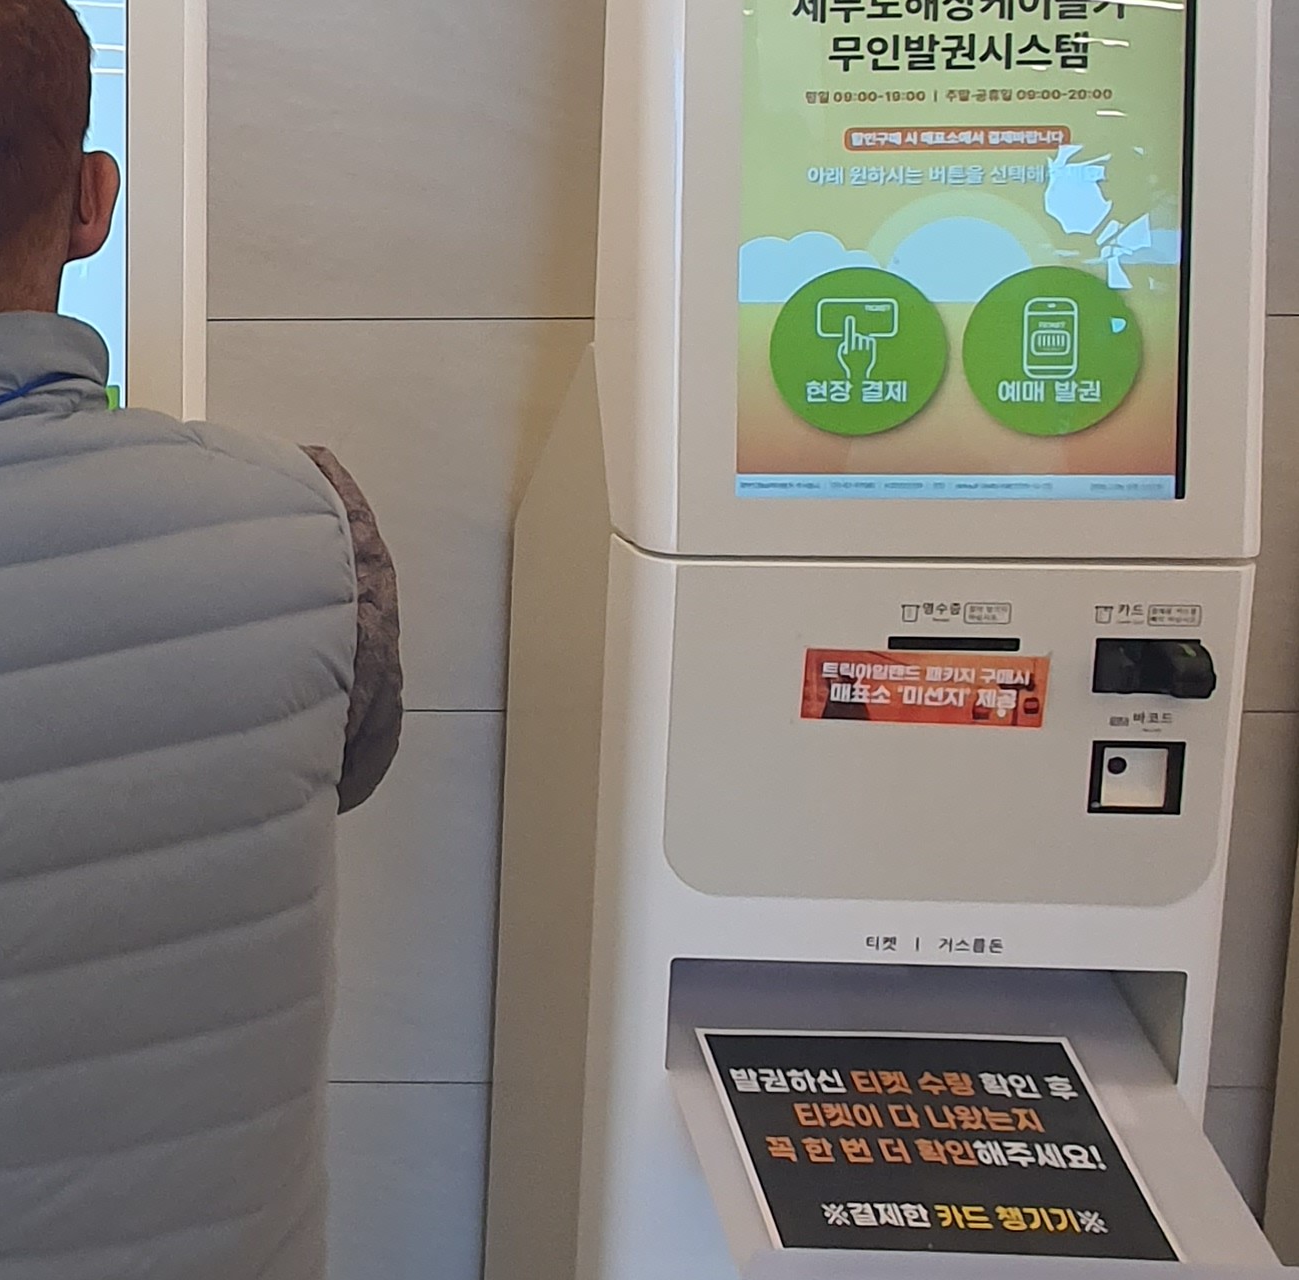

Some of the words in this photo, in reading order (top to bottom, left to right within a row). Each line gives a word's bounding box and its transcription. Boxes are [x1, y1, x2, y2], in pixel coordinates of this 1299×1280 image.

[828, 30, 1090, 72] 무인발권시스템
[905, 131, 918, 145] 시
[807, 165, 844, 185] 아래
[850, 165, 923, 186] 원하시는
[929, 165, 984, 185] 버튼을
[805, 379, 854, 403] 현장
[861, 379, 908, 403] 결제
[997, 379, 1045, 403] 예매
[1054, 379, 1102, 403] 발권
[1118, 604, 1145, 617] 카드
[925, 666, 976, 684] 패키지
[829, 682, 891, 705] 매표소
[976, 688, 1019, 711] 제공
[1132, 711, 1173, 725] 바코드
[866, 935, 898, 951] 티켓
[728, 1066, 848, 1096] 발권하신
[849, 1069, 914, 1097] 티켓
[917, 1070, 977, 1097] 수량
[978, 1071, 1043, 1100] 확인
[1044, 1073, 1080, 1102] 후
[792, 1102, 885, 1130] 티켓이
[887, 1103, 920, 1130] 다
[923, 1104, 1047, 1134] 나왔는지
[765, 1134, 800, 1164] 꼭
[801, 1135, 837, 1164] 한
[839, 1136, 876, 1166] 번
[877, 1137, 913, 1166] 더
[914, 1136, 1108, 1173] 확인해주세요!
[933, 1204, 995, 1230] 카드
